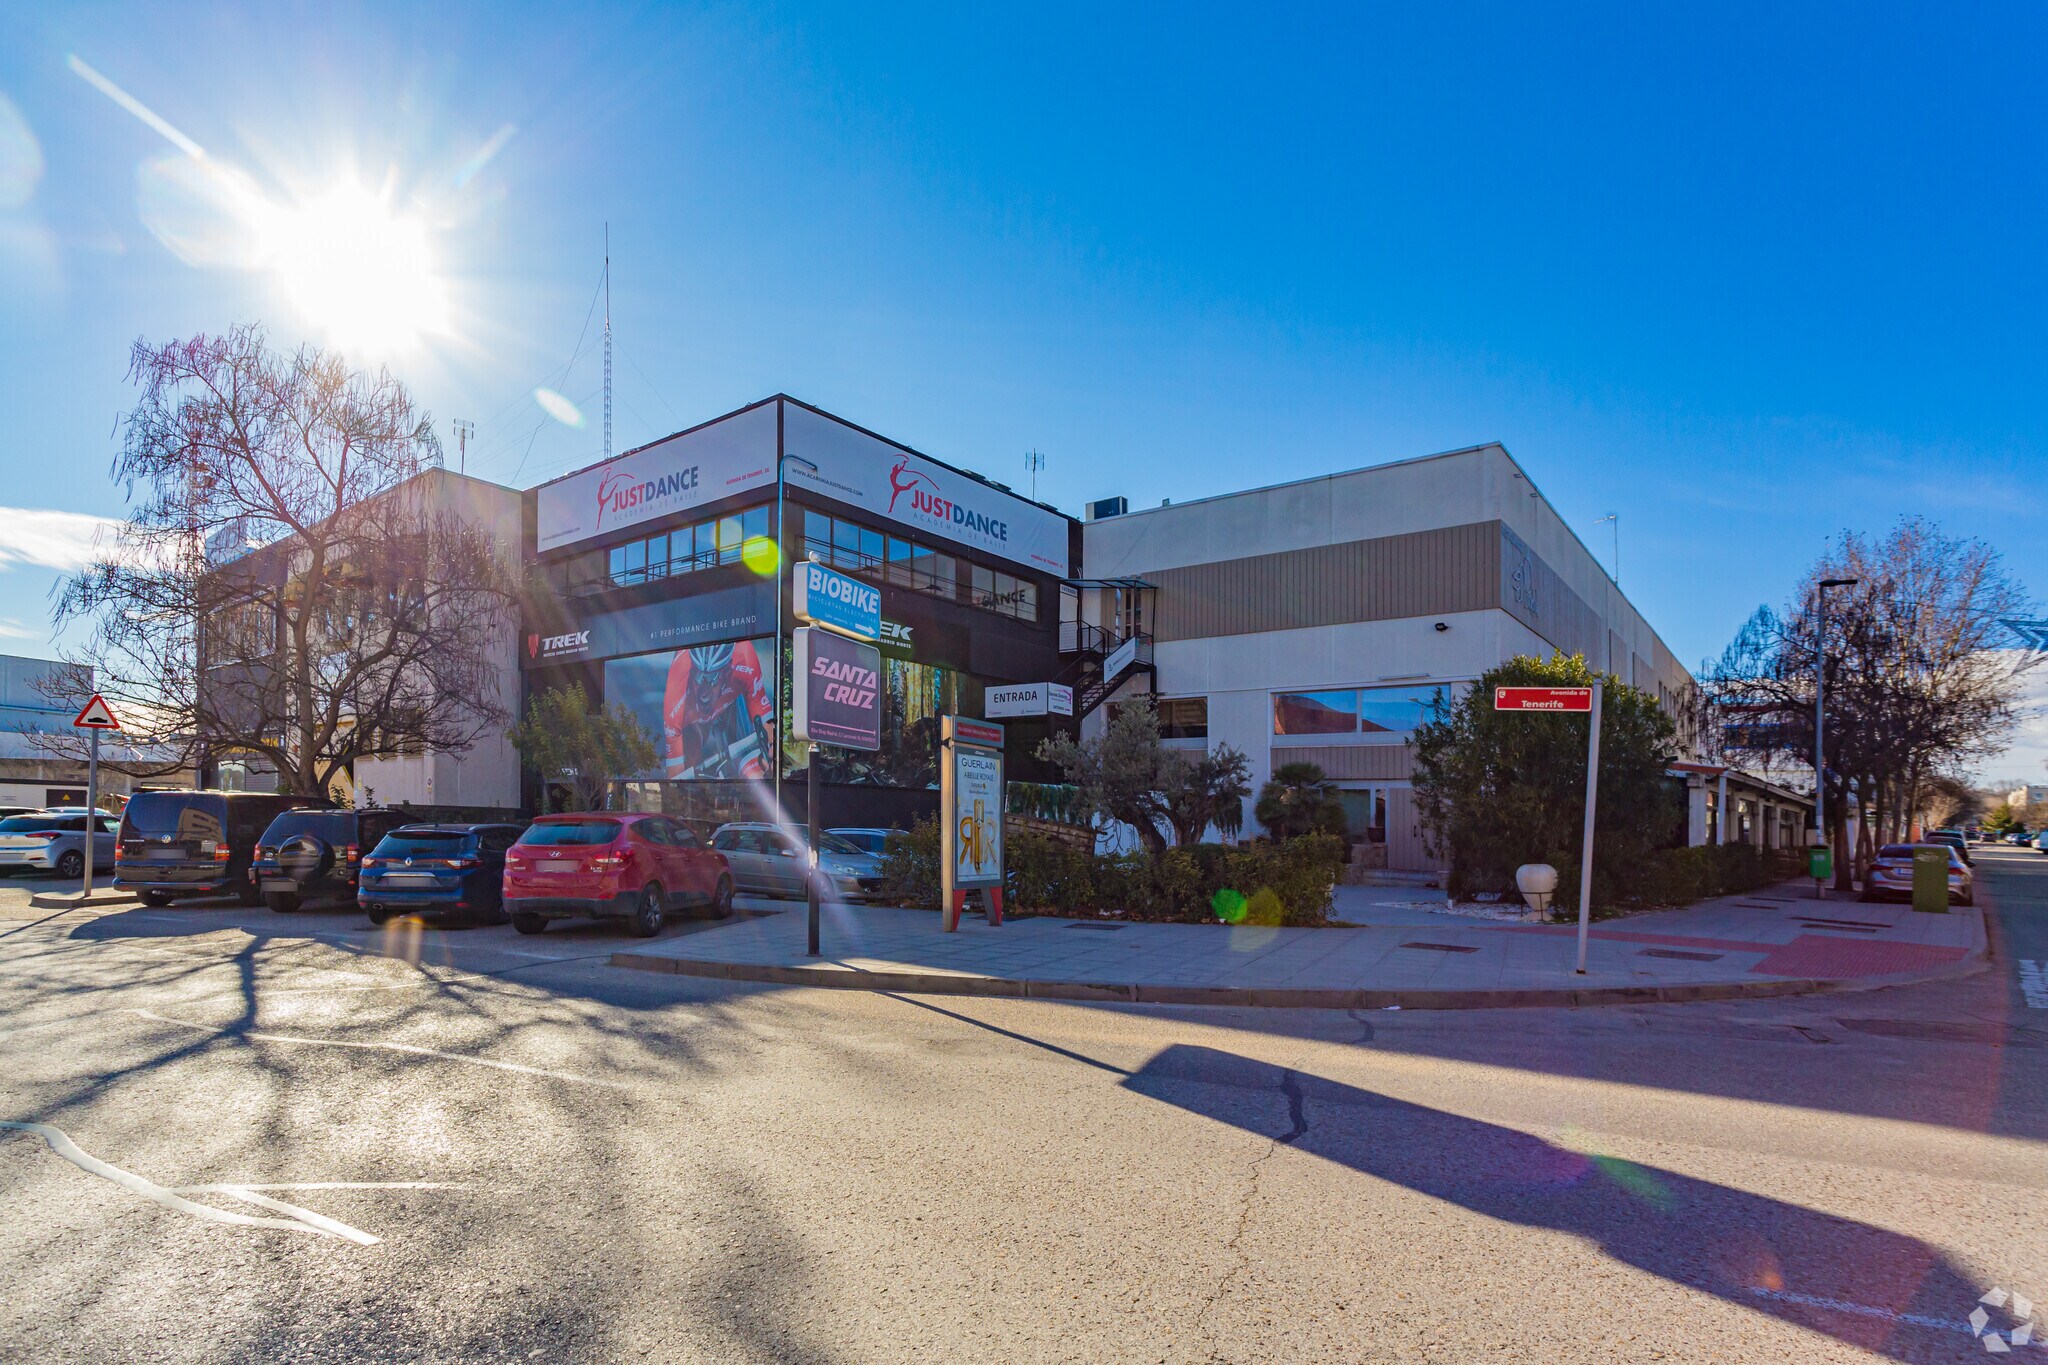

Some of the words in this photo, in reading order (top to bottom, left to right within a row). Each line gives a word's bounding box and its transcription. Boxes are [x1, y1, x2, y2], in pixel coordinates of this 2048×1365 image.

[612, 466, 699, 513] JUSTDANCE
[614, 505, 653, 521] ACADEMIA
[659, 500, 668, 508] DE
[911, 489, 1007, 541] JUSTDANCE
[913, 512, 962, 534] ACADEMIA
[968, 531, 977, 540] DE
[809, 566, 879, 614] BIOBIKE
[650, 631, 658, 639] #1
[660, 622, 710, 638] PERFORMANCE
[712, 620, 728, 631] BIKE
[731, 615, 757, 628] BRAND
[542, 630, 591, 651] TREK
[811, 656, 877, 689] SANTA
[823, 682, 876, 710] CRUZ
[993, 690, 1038, 704] ENTRADA
[1521, 700, 1564, 709] Tenerife
[961, 757, 996, 771] GUERLAIN
[963, 771, 979, 780] ABEILLE
[979, 772, 994, 780] ROYALE
